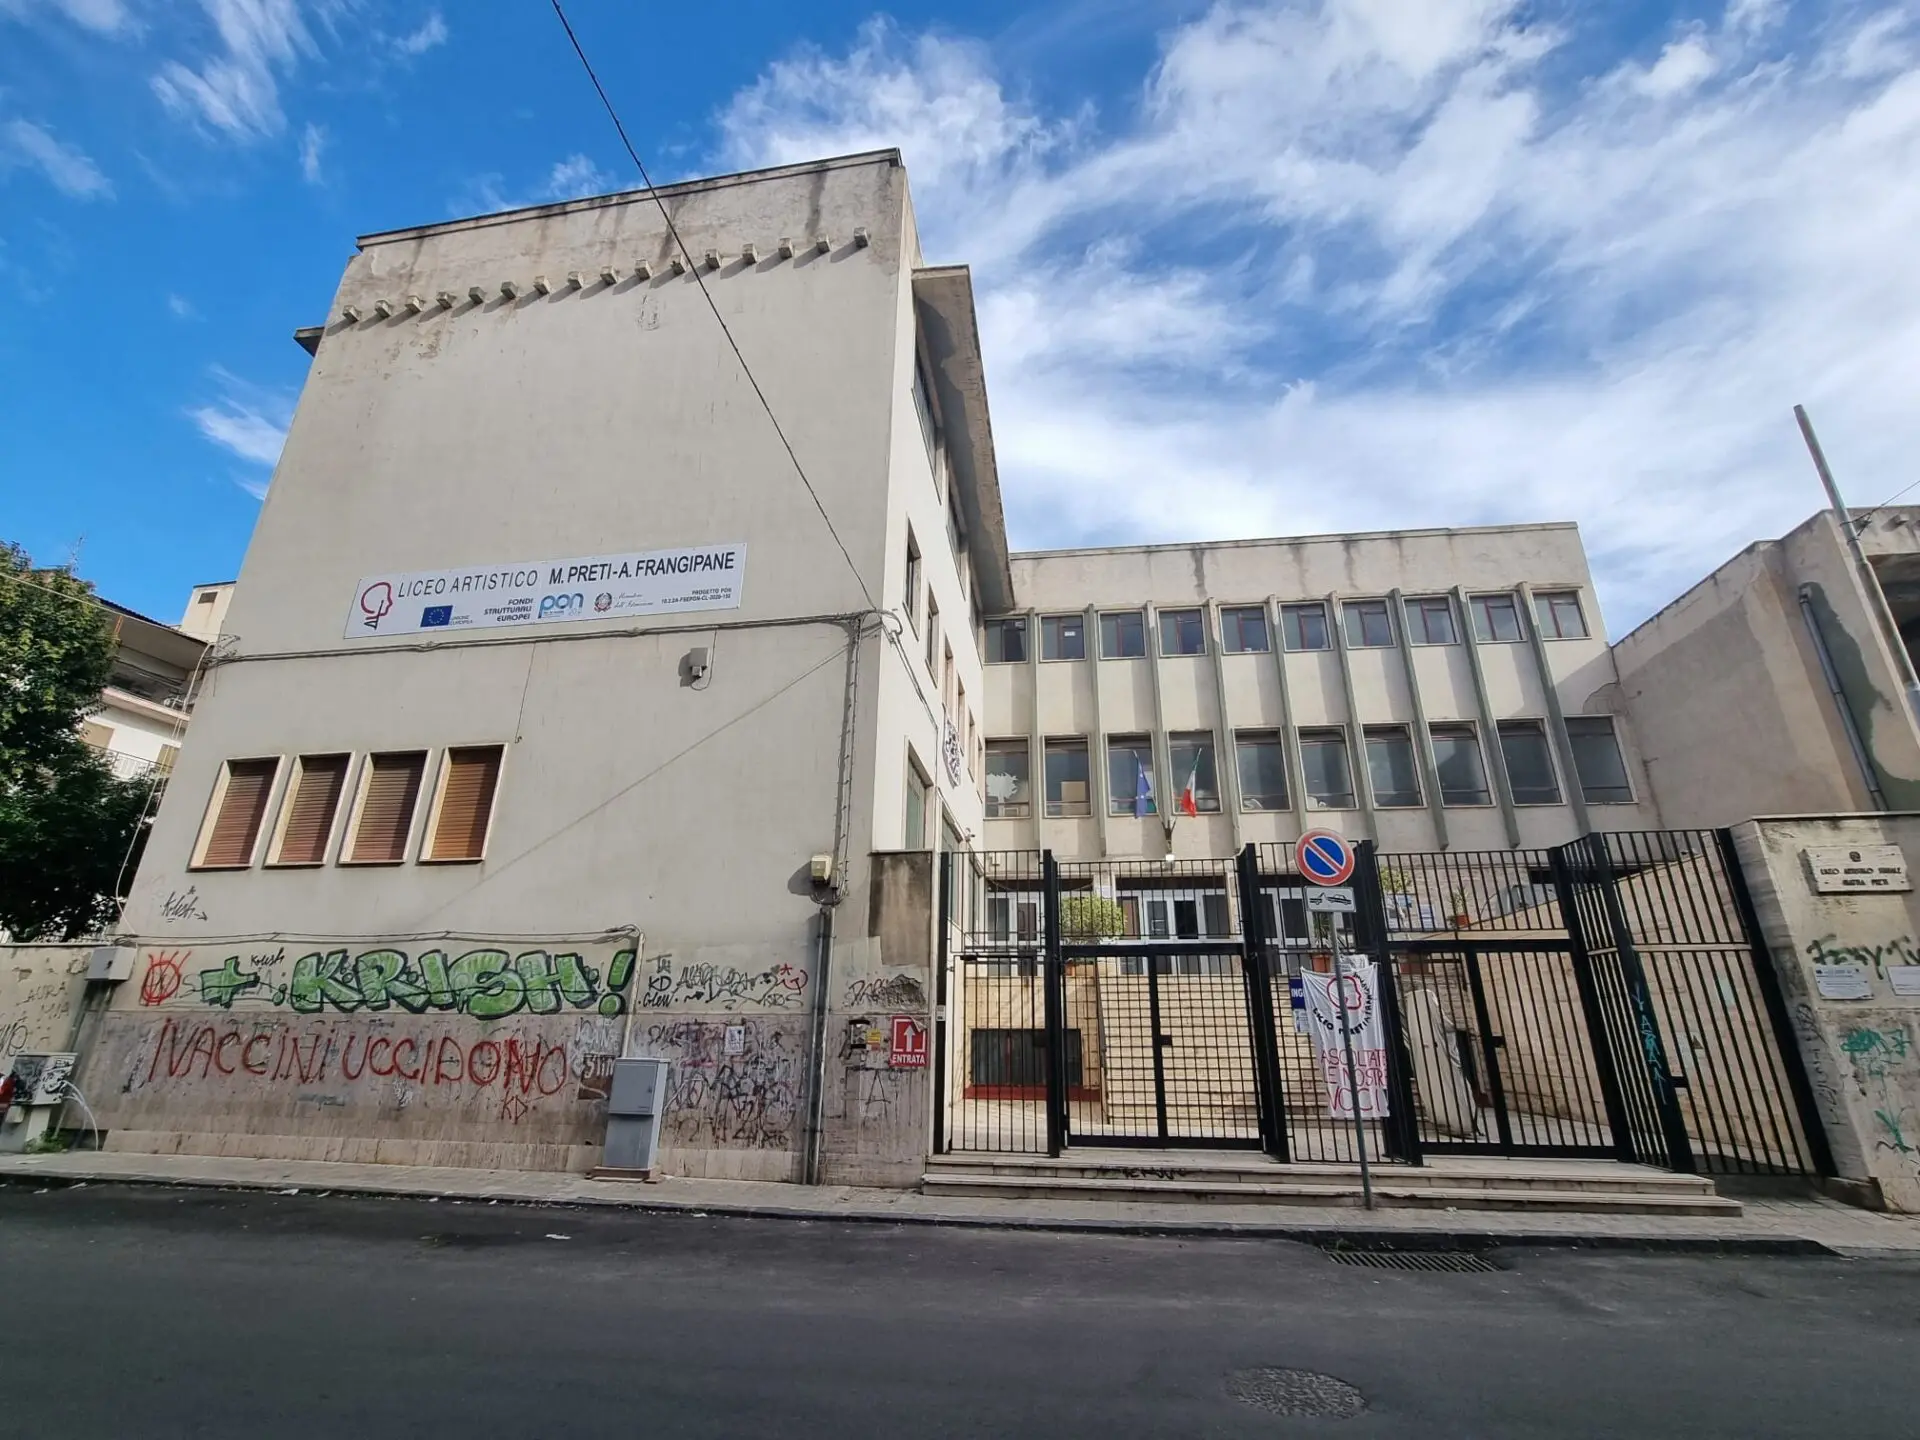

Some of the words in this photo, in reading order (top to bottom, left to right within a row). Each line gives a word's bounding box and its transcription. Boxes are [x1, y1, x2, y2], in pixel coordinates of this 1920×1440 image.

[398, 579, 446, 598] LICEO
[450, 570, 538, 593] ARTISTICO
[635, 551, 735, 577] FRANGIPANE
[484, 606, 532, 616] STRUTTURALI
[497, 614, 531, 622] EUROPEI
[892, 1053, 926, 1064] ENTRATA
[1323, 1066, 1337, 1084] LE
[1326, 1086, 1380, 1111] VOCI
